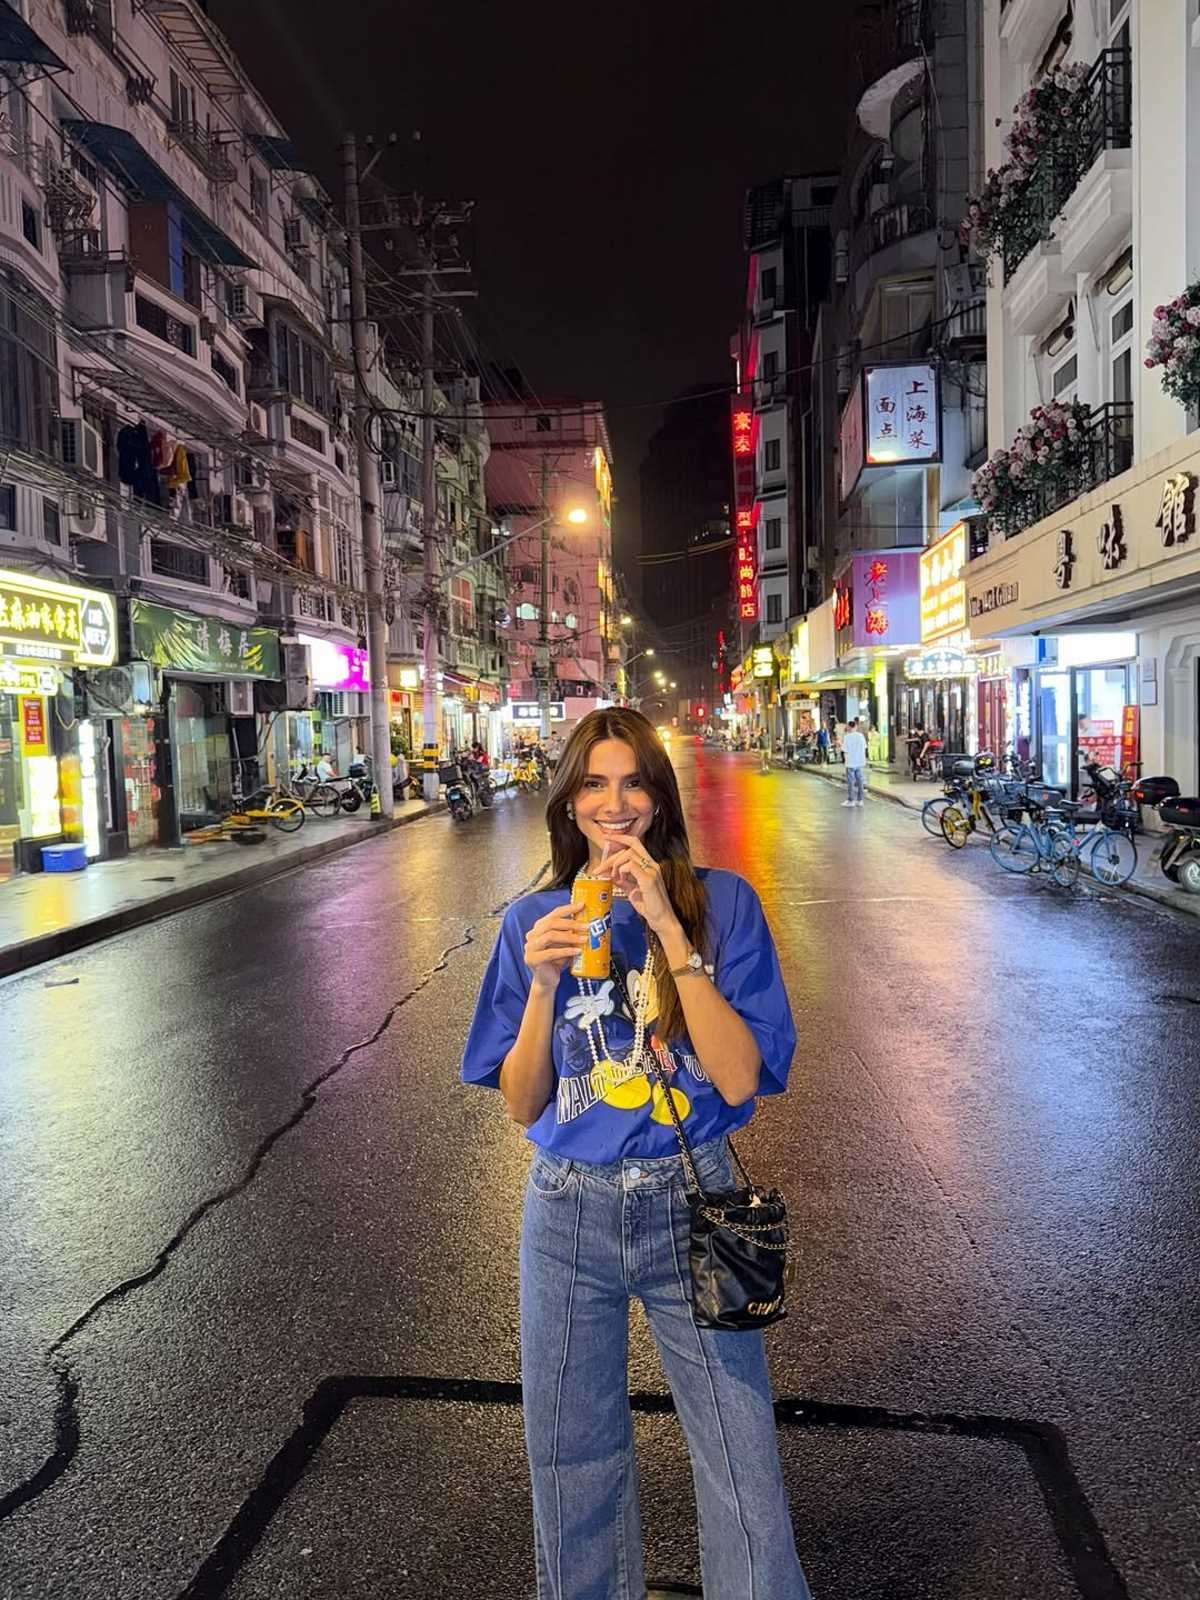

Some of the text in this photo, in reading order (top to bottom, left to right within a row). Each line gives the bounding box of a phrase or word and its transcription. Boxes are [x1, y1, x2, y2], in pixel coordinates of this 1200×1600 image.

[875, 396, 898, 440] 面点
[905, 380, 931, 449] 上海菜
[864, 560, 888, 635] 老上海
[557, 1077, 608, 1124] WALT
